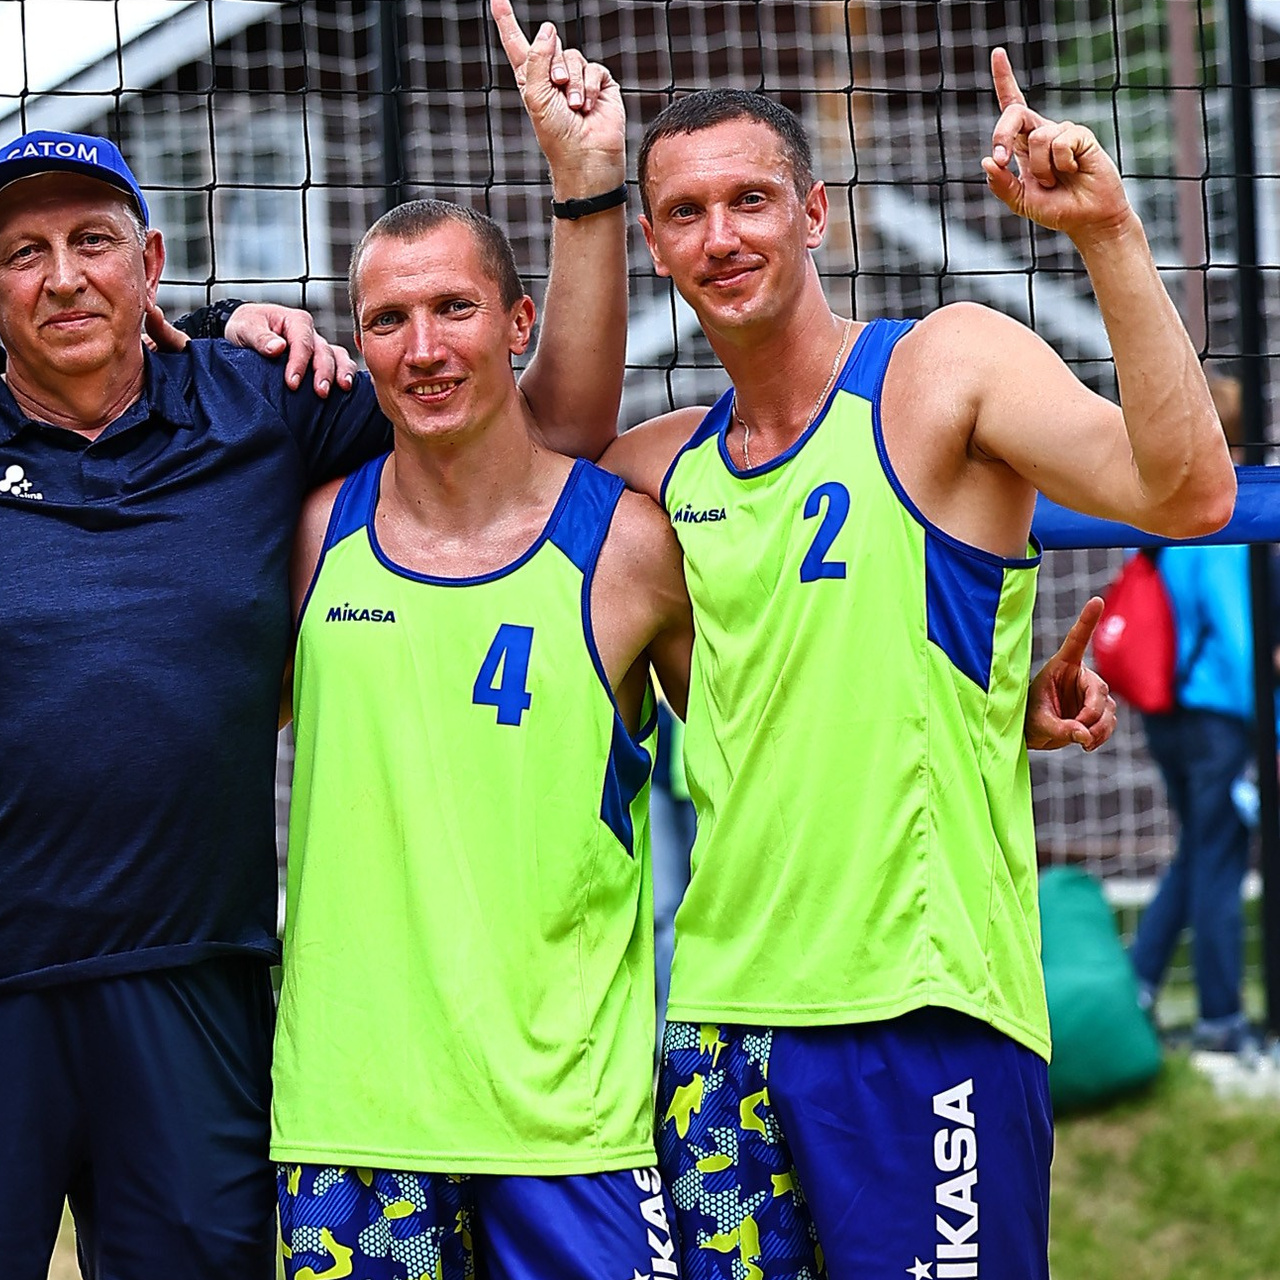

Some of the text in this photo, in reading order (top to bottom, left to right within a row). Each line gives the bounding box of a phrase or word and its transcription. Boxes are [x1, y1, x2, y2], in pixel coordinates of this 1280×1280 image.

[673, 503, 727, 523] MIKASA
[800, 481, 851, 583] 2
[325, 602, 396, 623] MIKASA
[472, 623, 535, 727] 4
